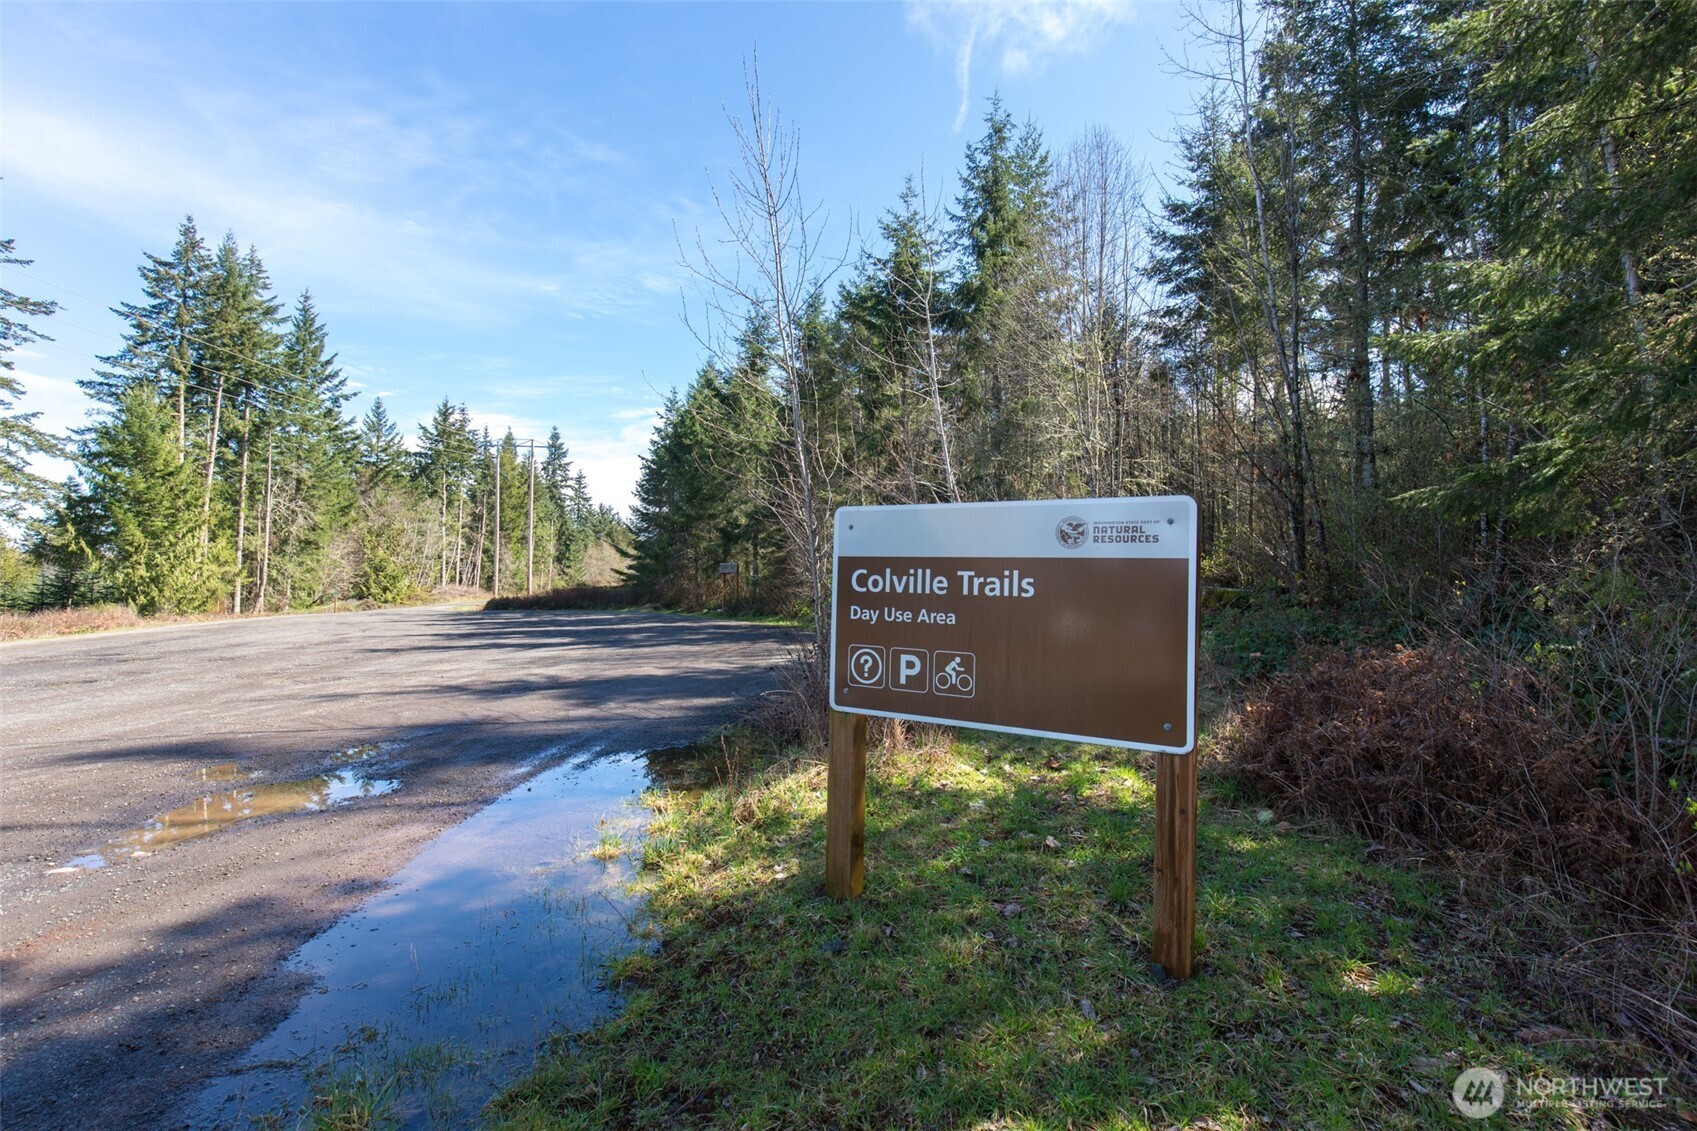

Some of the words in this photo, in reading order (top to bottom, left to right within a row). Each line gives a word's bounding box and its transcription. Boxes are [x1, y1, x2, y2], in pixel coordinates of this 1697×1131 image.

[1093, 525, 1146, 534] NATURAL
[1093, 534, 1159, 543] RESOURCES
[851, 567, 949, 595] Colville
[957, 569, 1035, 598] Trails
[850, 605, 879, 624] Day
[884, 607, 912, 623] Use
[917, 608, 956, 624] Area
[899, 654, 921, 685] P
